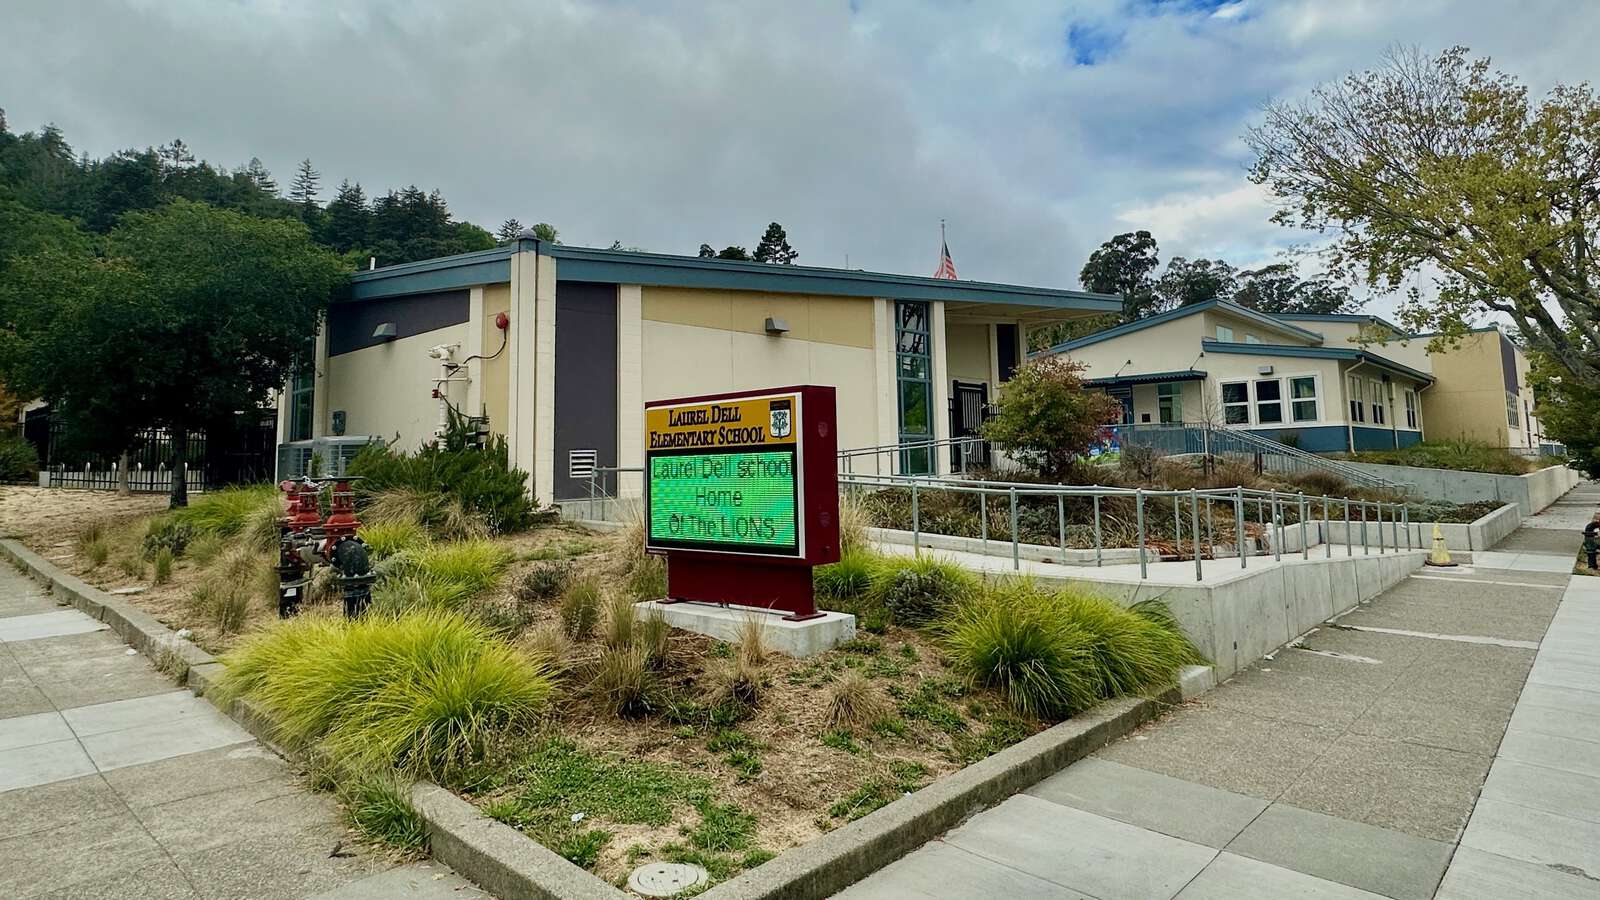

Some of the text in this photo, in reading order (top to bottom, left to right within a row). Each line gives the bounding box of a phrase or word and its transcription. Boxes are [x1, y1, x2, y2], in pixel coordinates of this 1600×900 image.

[669, 405, 741, 427] LAUREL DELL
[650, 426, 765, 448] ELEMENTARY SCHOOL
[652, 453, 793, 479] Laurel Dell school
[695, 486, 743, 507] Home
[688, 515, 716, 535] The
[721, 516, 775, 539] LIONS
